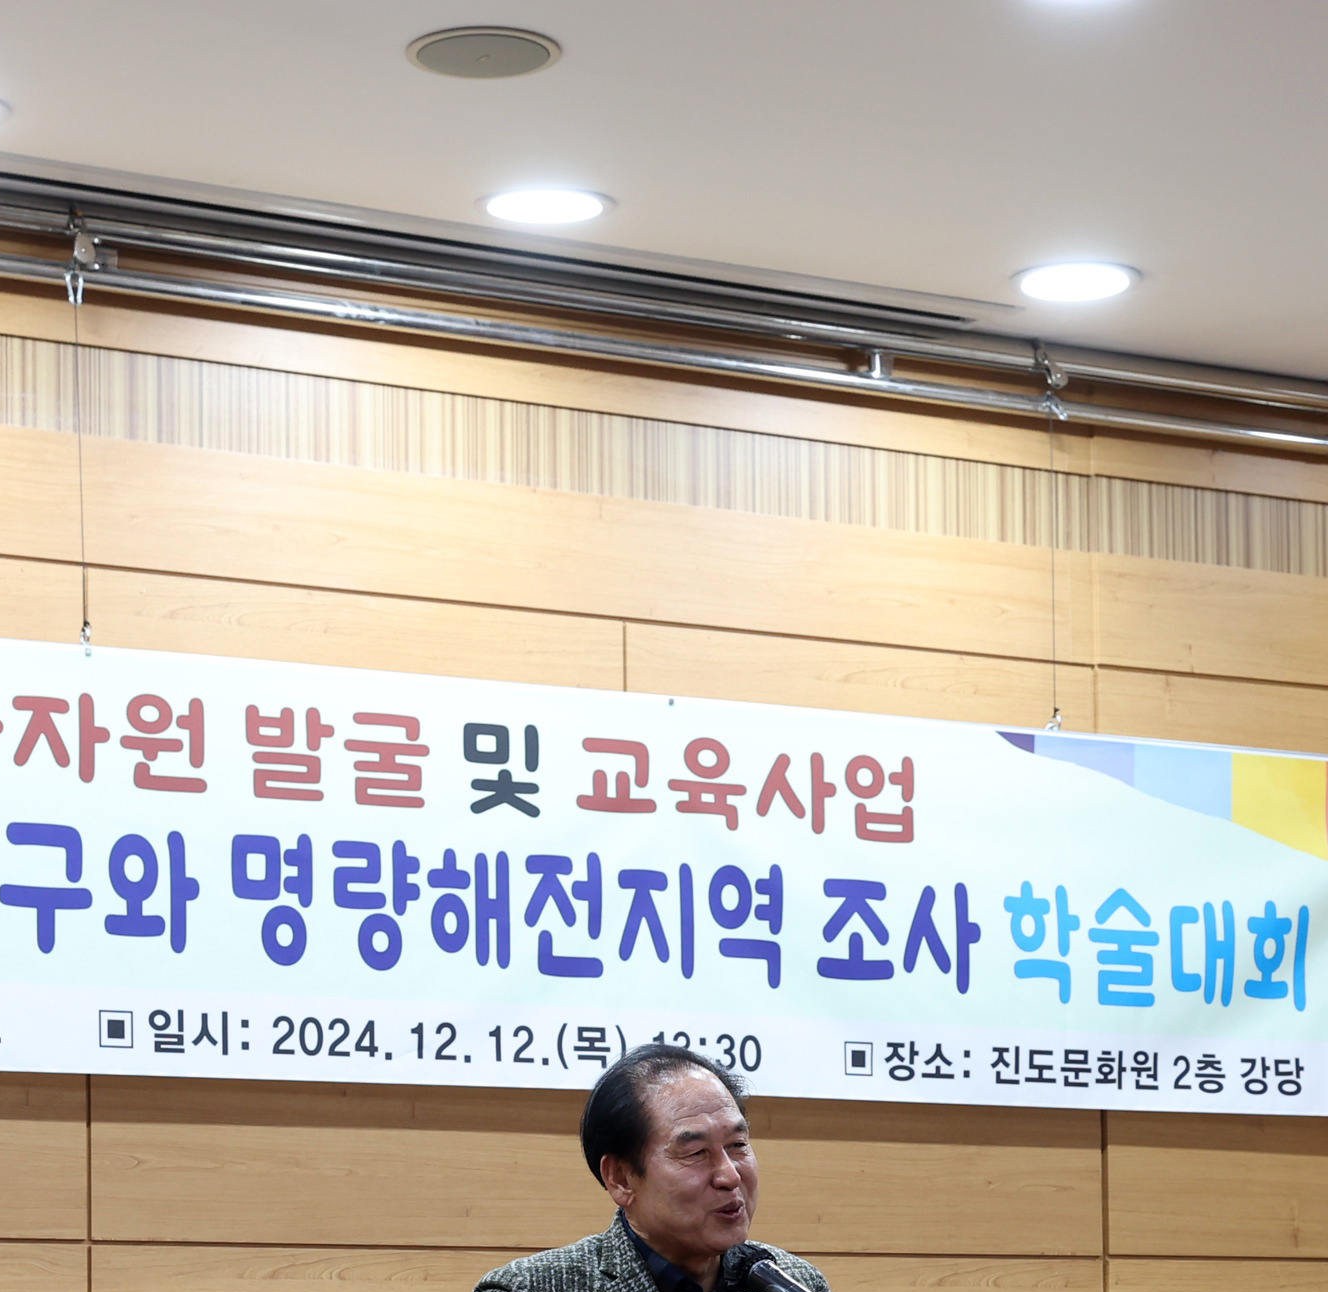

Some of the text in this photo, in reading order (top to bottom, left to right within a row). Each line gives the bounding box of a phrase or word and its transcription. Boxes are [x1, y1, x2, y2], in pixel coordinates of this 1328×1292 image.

[245, 704, 430, 809] 발굴
[462, 722, 541, 819] 및
[575, 737, 915, 844] 교육사업
[230, 833, 783, 990] 명량해전지역
[816, 878, 982, 995] 조사
[1003, 880, 1311, 1013] 학술대회
[148, 1008, 250, 1056] 일시:
[884, 1040, 1305, 1097] 장소: 진도문화원 2층 강당
